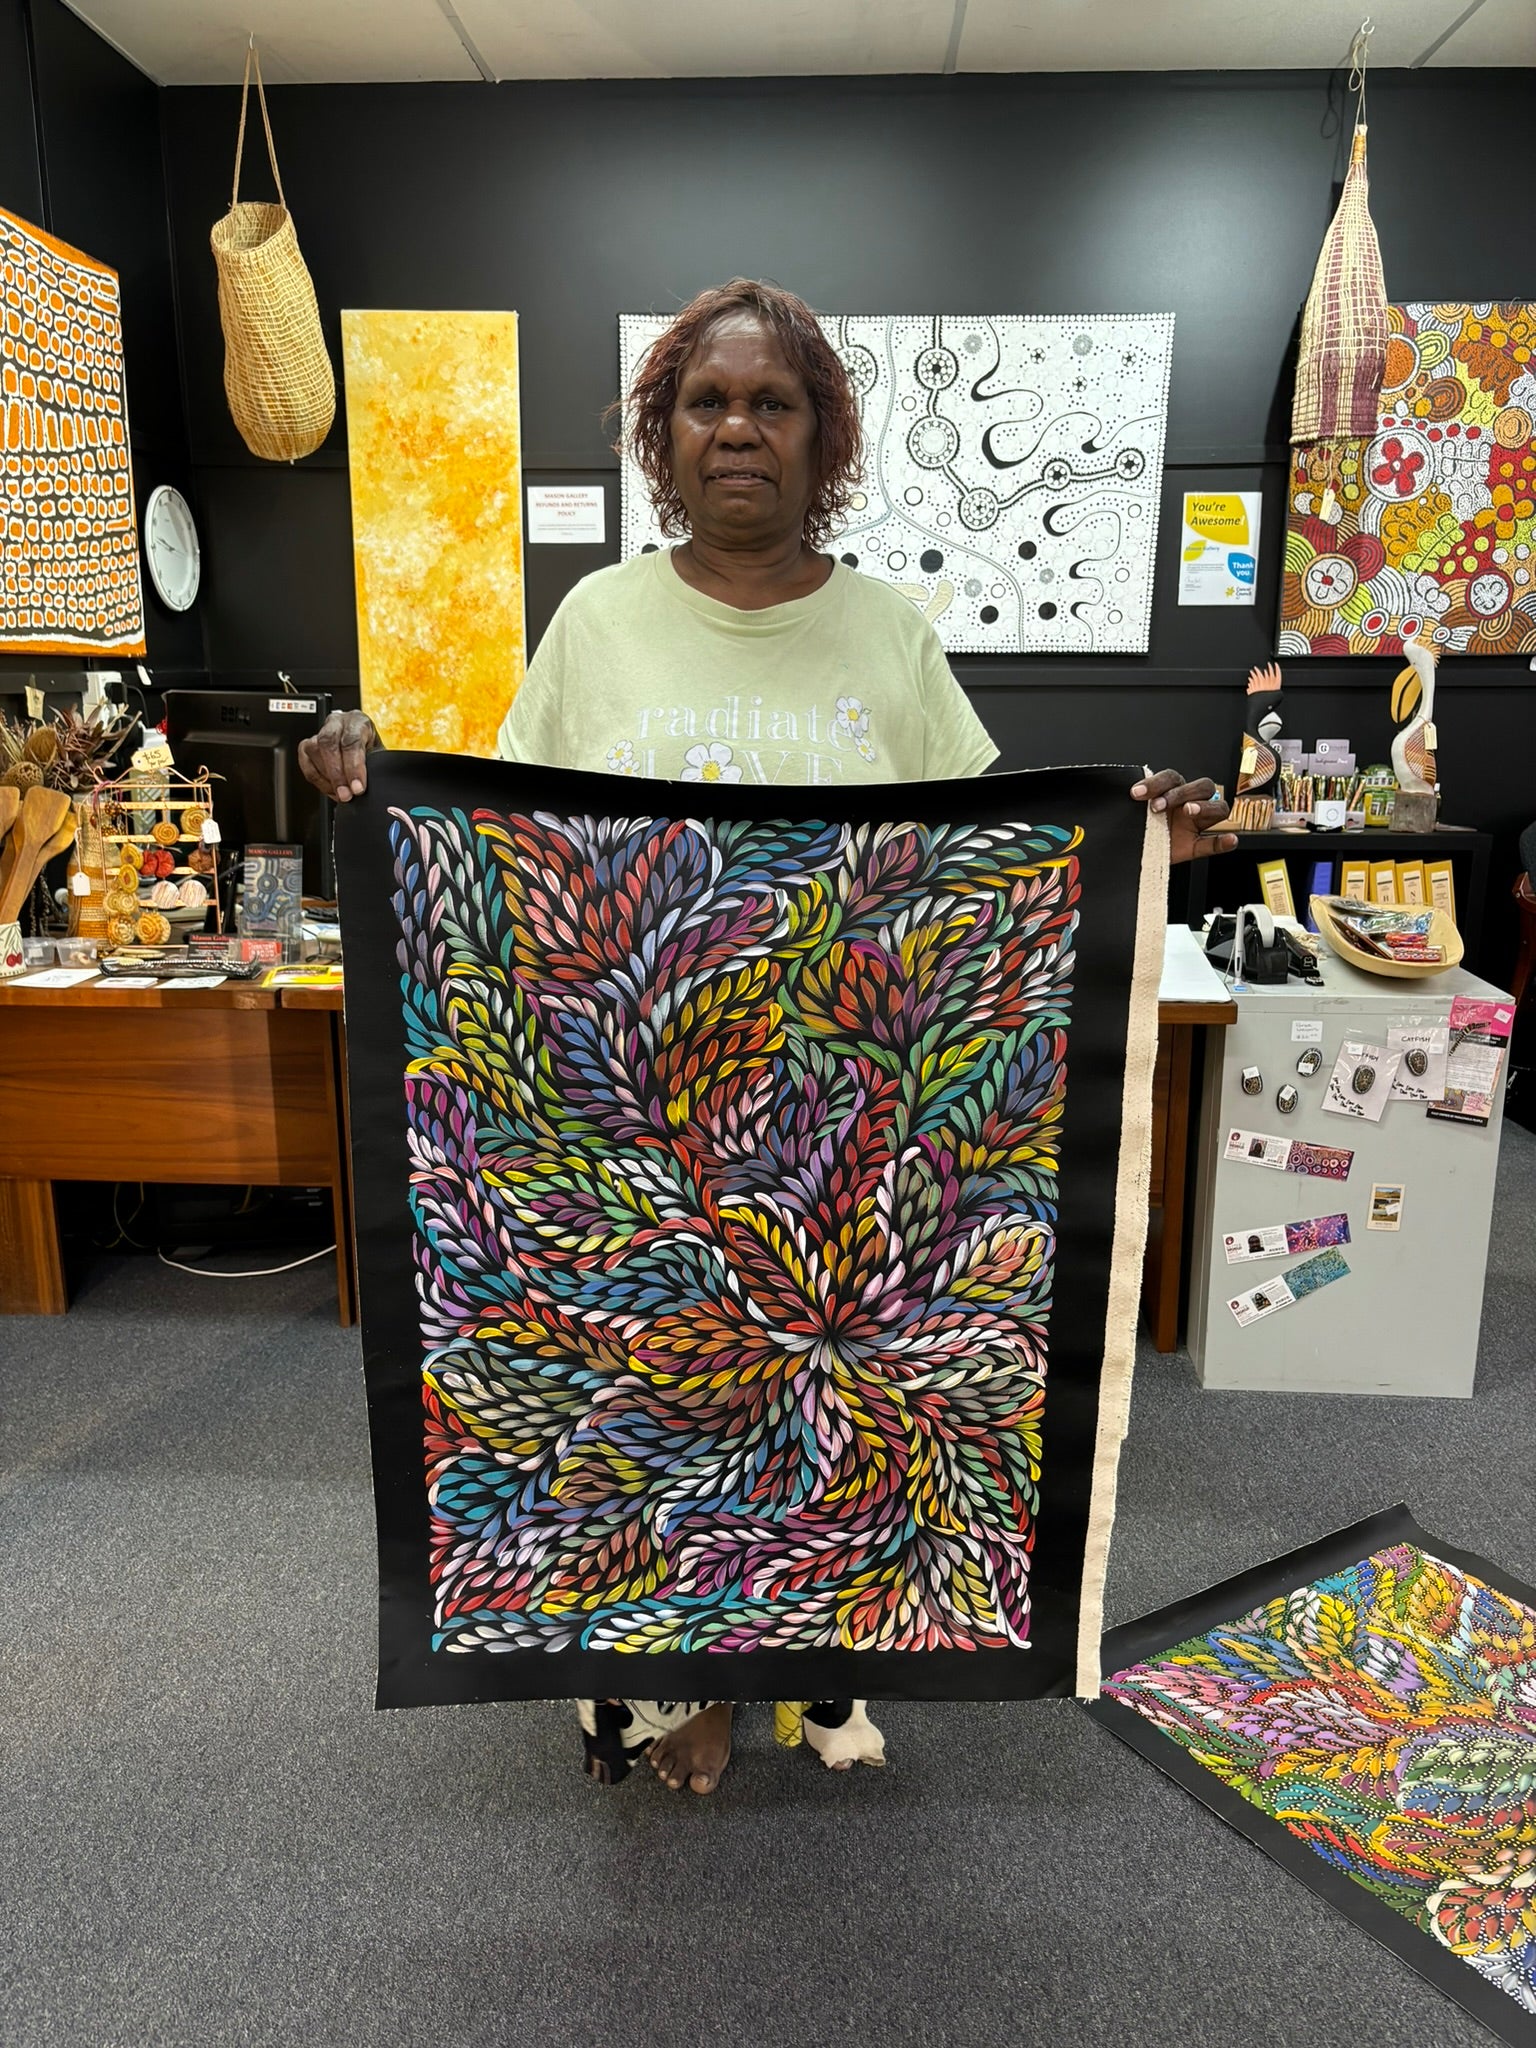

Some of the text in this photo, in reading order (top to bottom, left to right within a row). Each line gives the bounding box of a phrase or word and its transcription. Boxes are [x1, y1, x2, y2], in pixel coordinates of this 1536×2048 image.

[1192, 502, 1226, 511] You're
[1190, 516, 1245, 526] Awesome!
[636, 695, 854, 752] radiate
